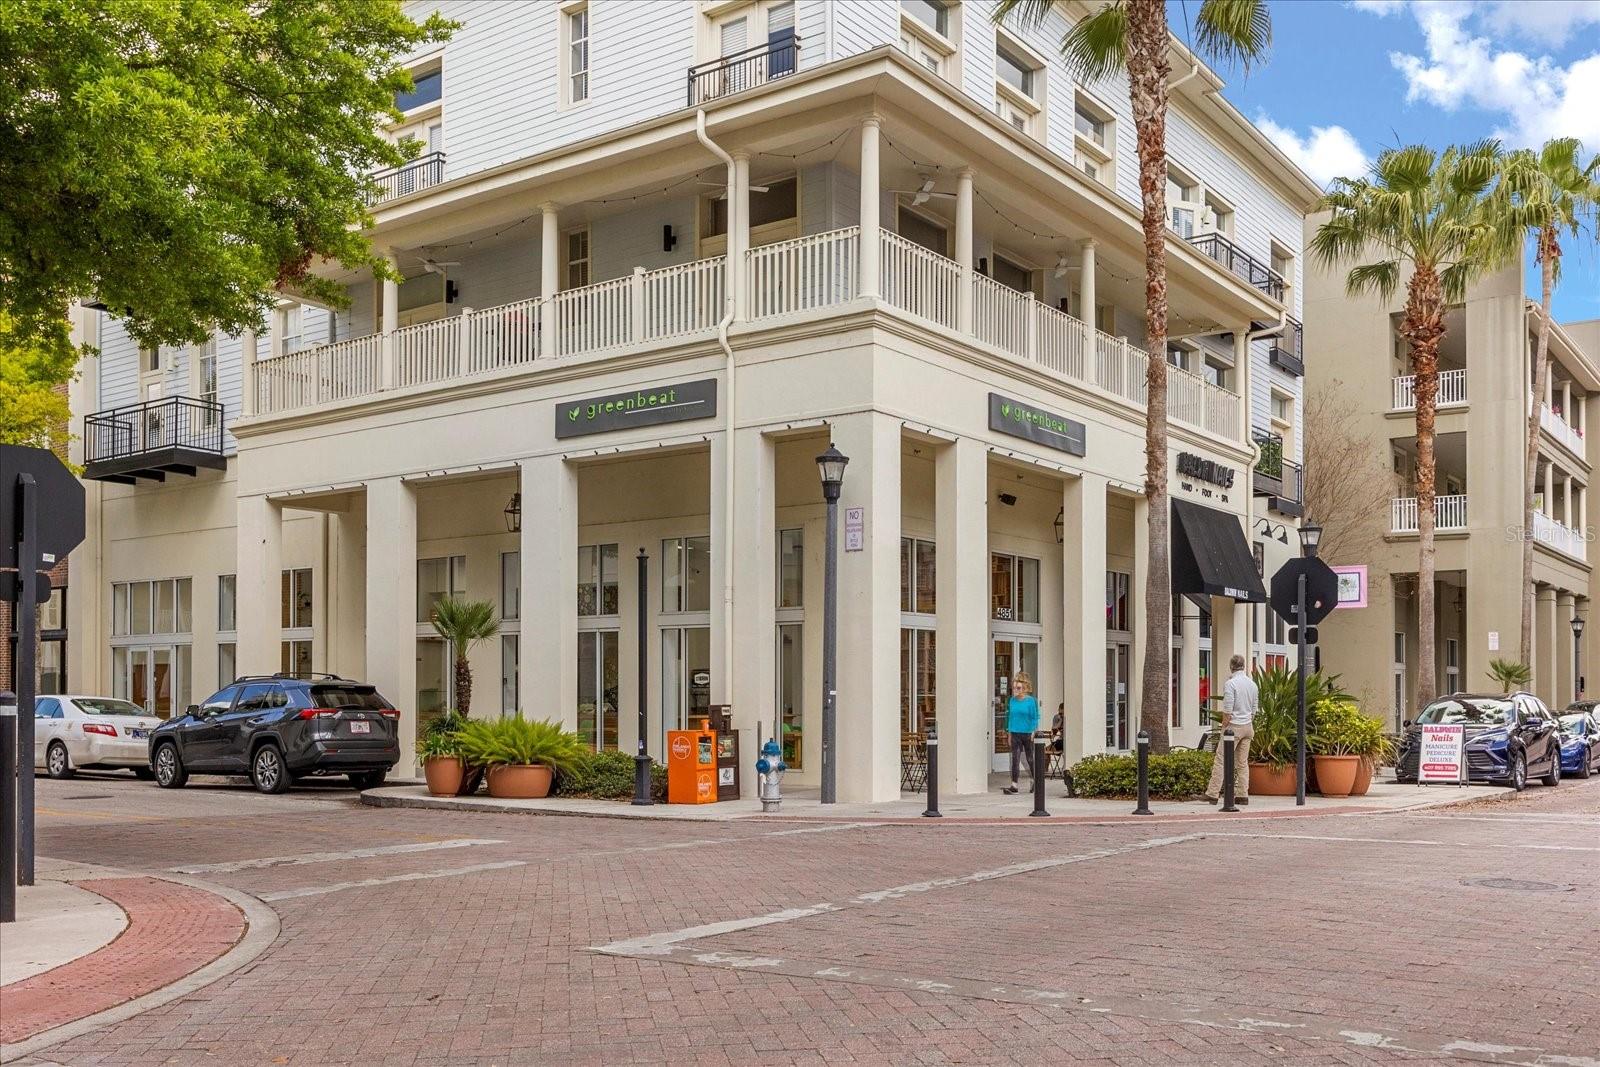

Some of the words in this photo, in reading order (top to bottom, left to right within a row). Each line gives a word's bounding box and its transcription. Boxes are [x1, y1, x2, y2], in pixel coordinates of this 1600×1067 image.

[586, 389, 676, 419] greenbeat
[1014, 407, 1068, 433] greenbeat
[849, 511, 860, 520] NO
[1430, 734, 1454, 742] Nails
